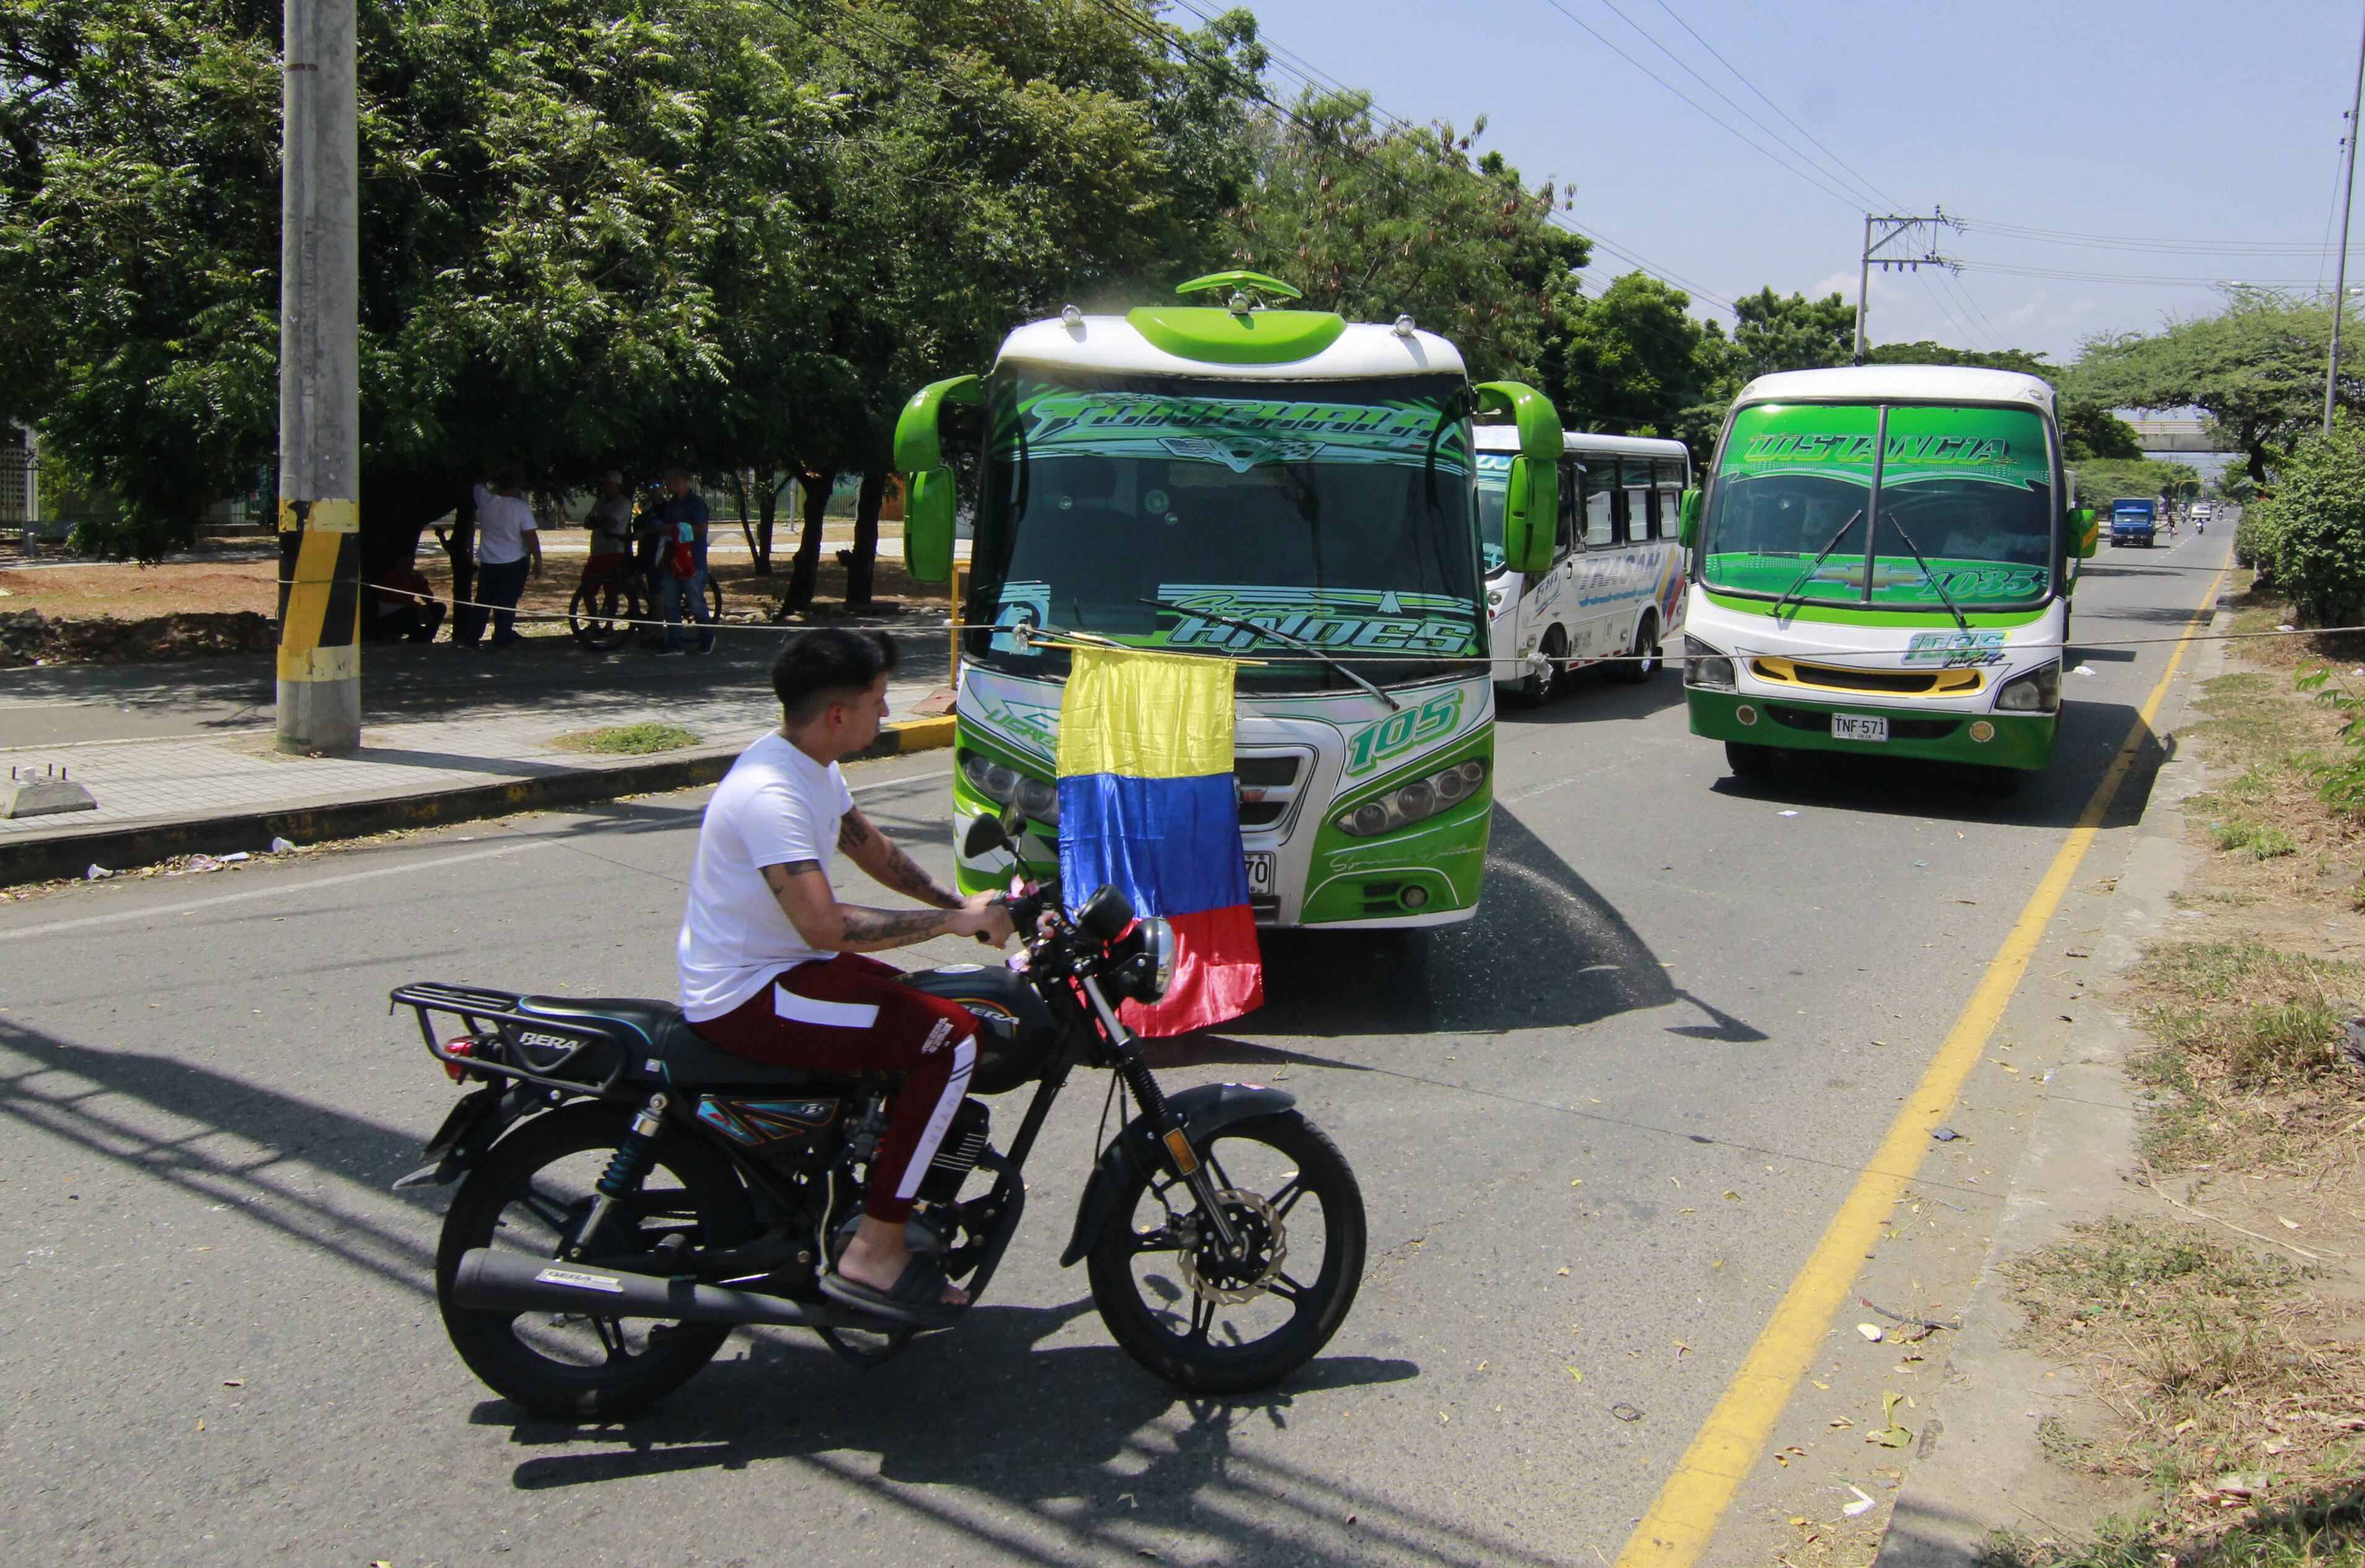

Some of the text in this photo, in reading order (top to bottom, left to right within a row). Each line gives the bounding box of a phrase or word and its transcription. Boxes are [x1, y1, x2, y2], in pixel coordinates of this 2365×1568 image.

[1917, 570, 2039, 599] 1035
[1347, 688, 1465, 776] 105
[963, 1005, 1020, 1026] ERA
[519, 1032, 580, 1052] BERA
